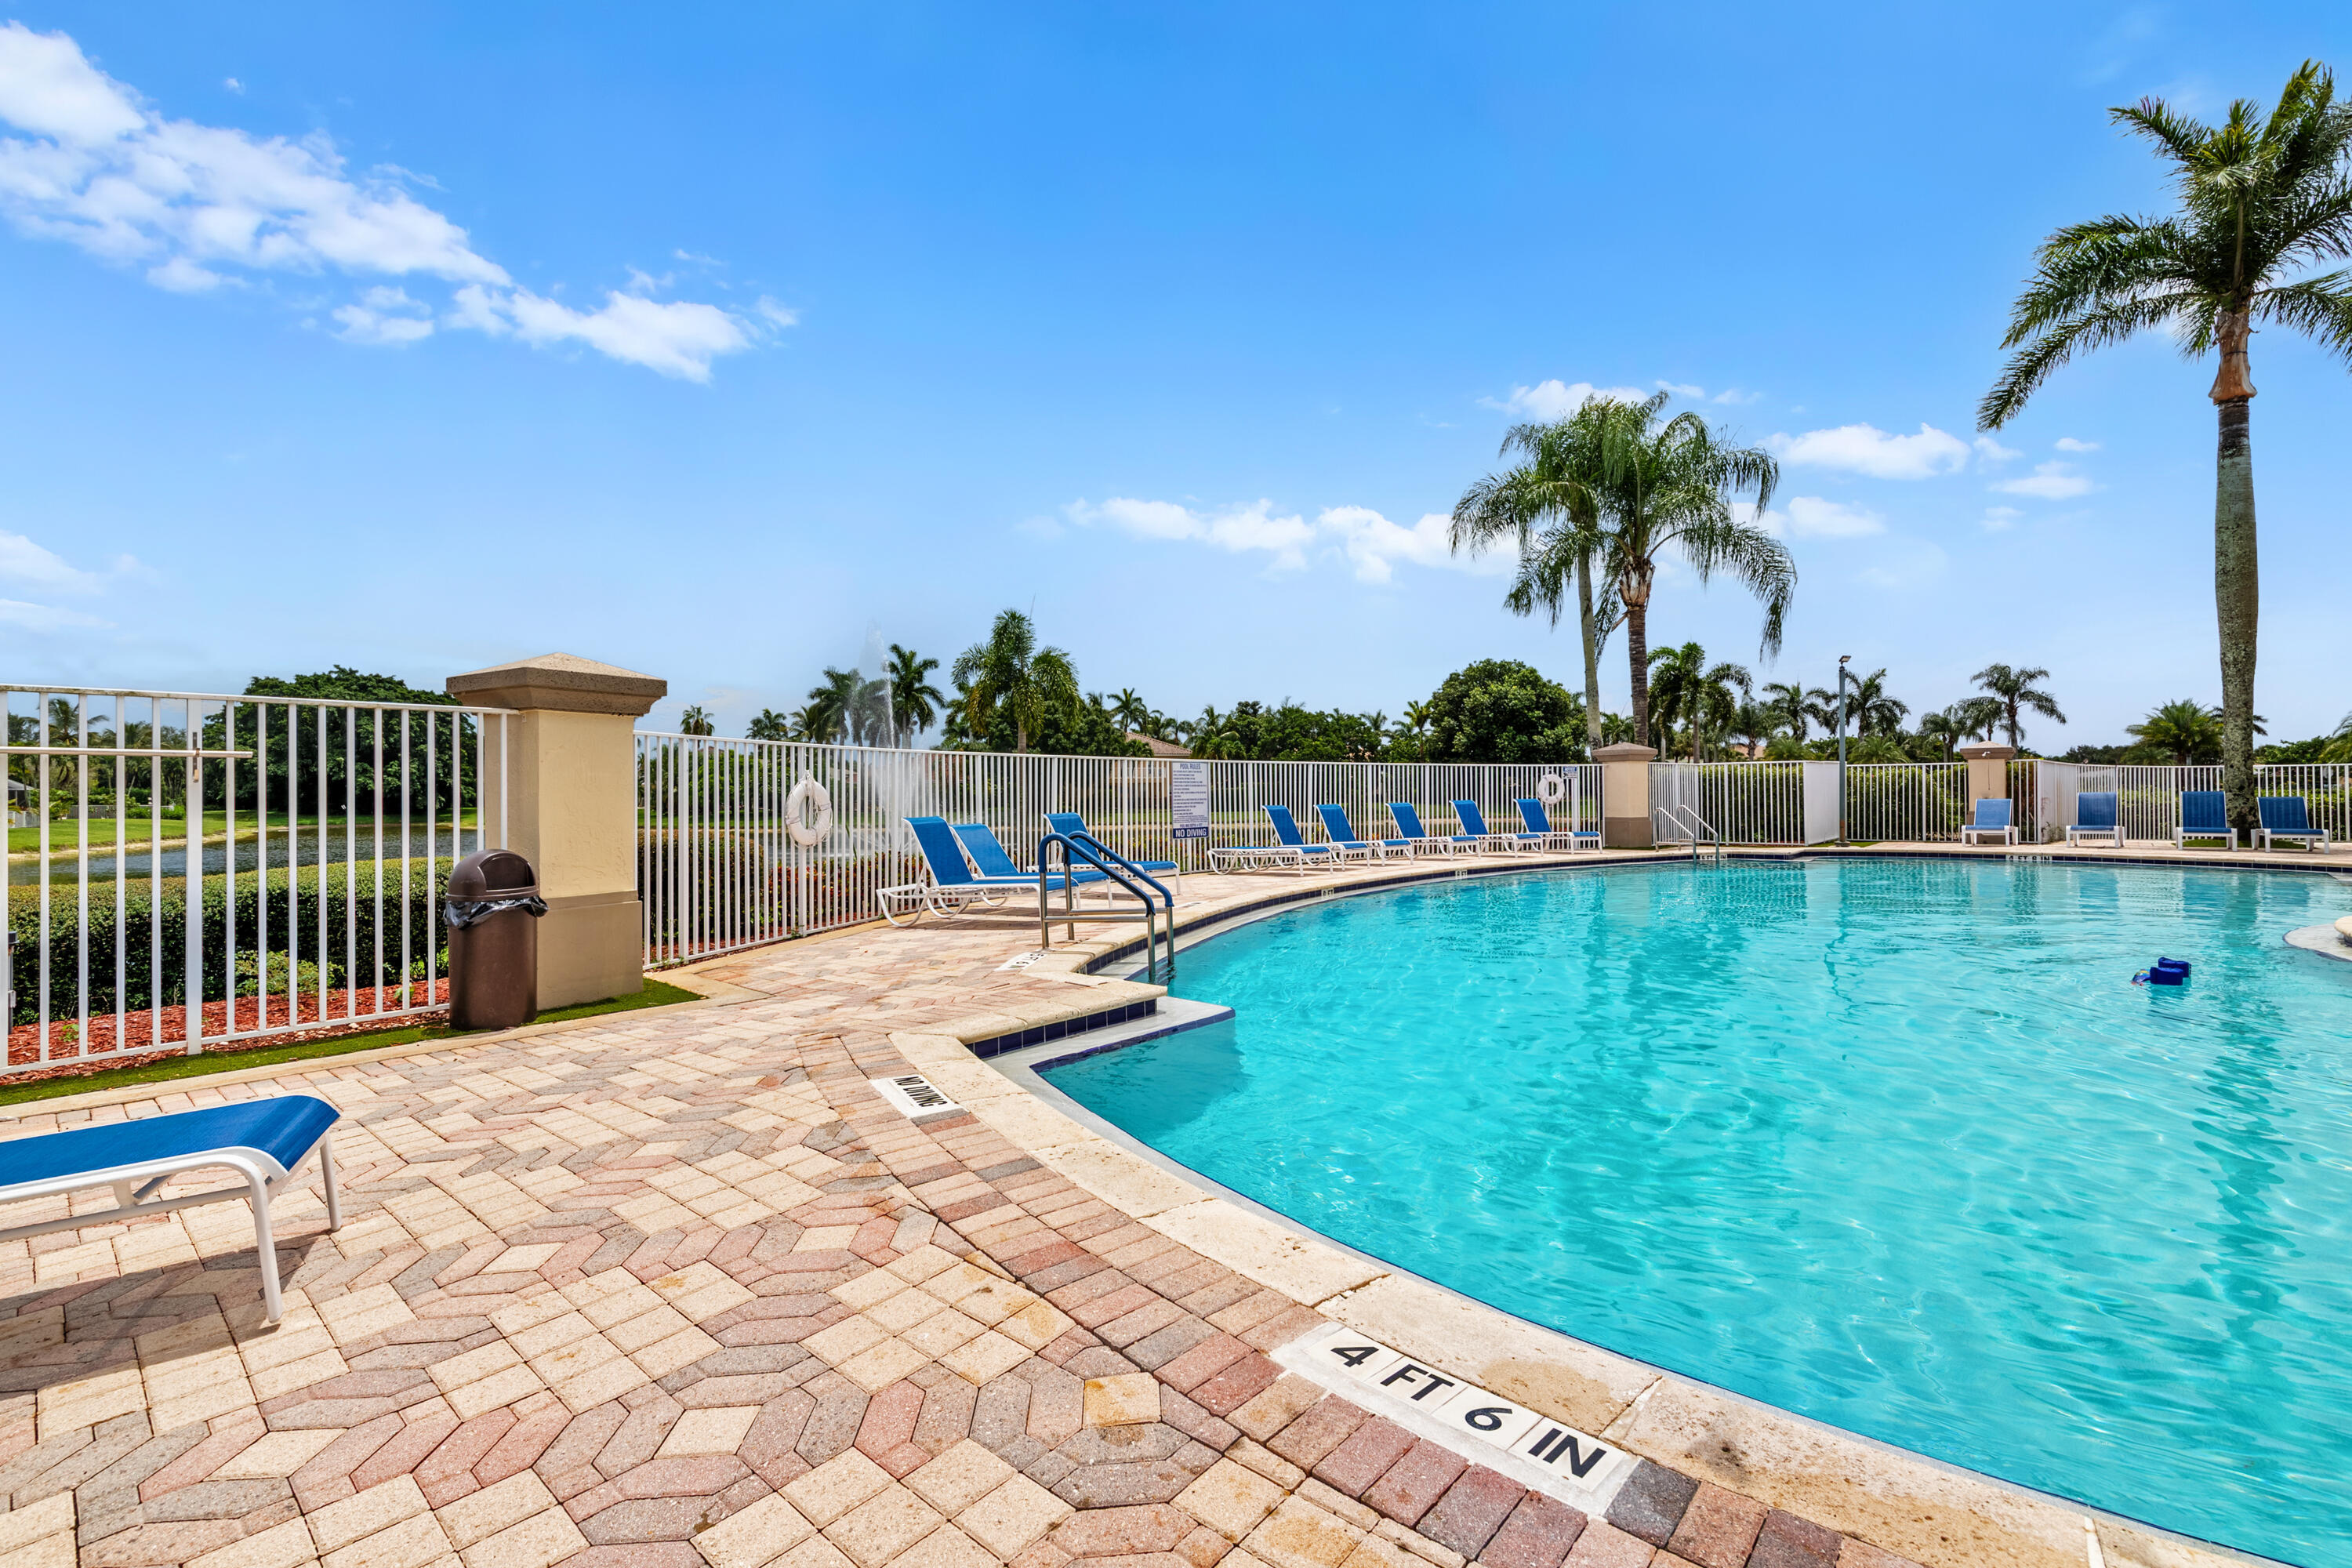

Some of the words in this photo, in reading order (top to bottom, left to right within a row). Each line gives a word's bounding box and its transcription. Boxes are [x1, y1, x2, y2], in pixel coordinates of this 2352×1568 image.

[1186, 828, 1207, 837] DIVING
[892, 1076, 924, 1086] NO
[903, 1086, 948, 1107] DIVING
[1330, 1346, 1379, 1367] 4
[1380, 1363, 1455, 1402] FT
[1465, 1407, 1513, 1432] 6
[1528, 1428, 1607, 1479] IN
